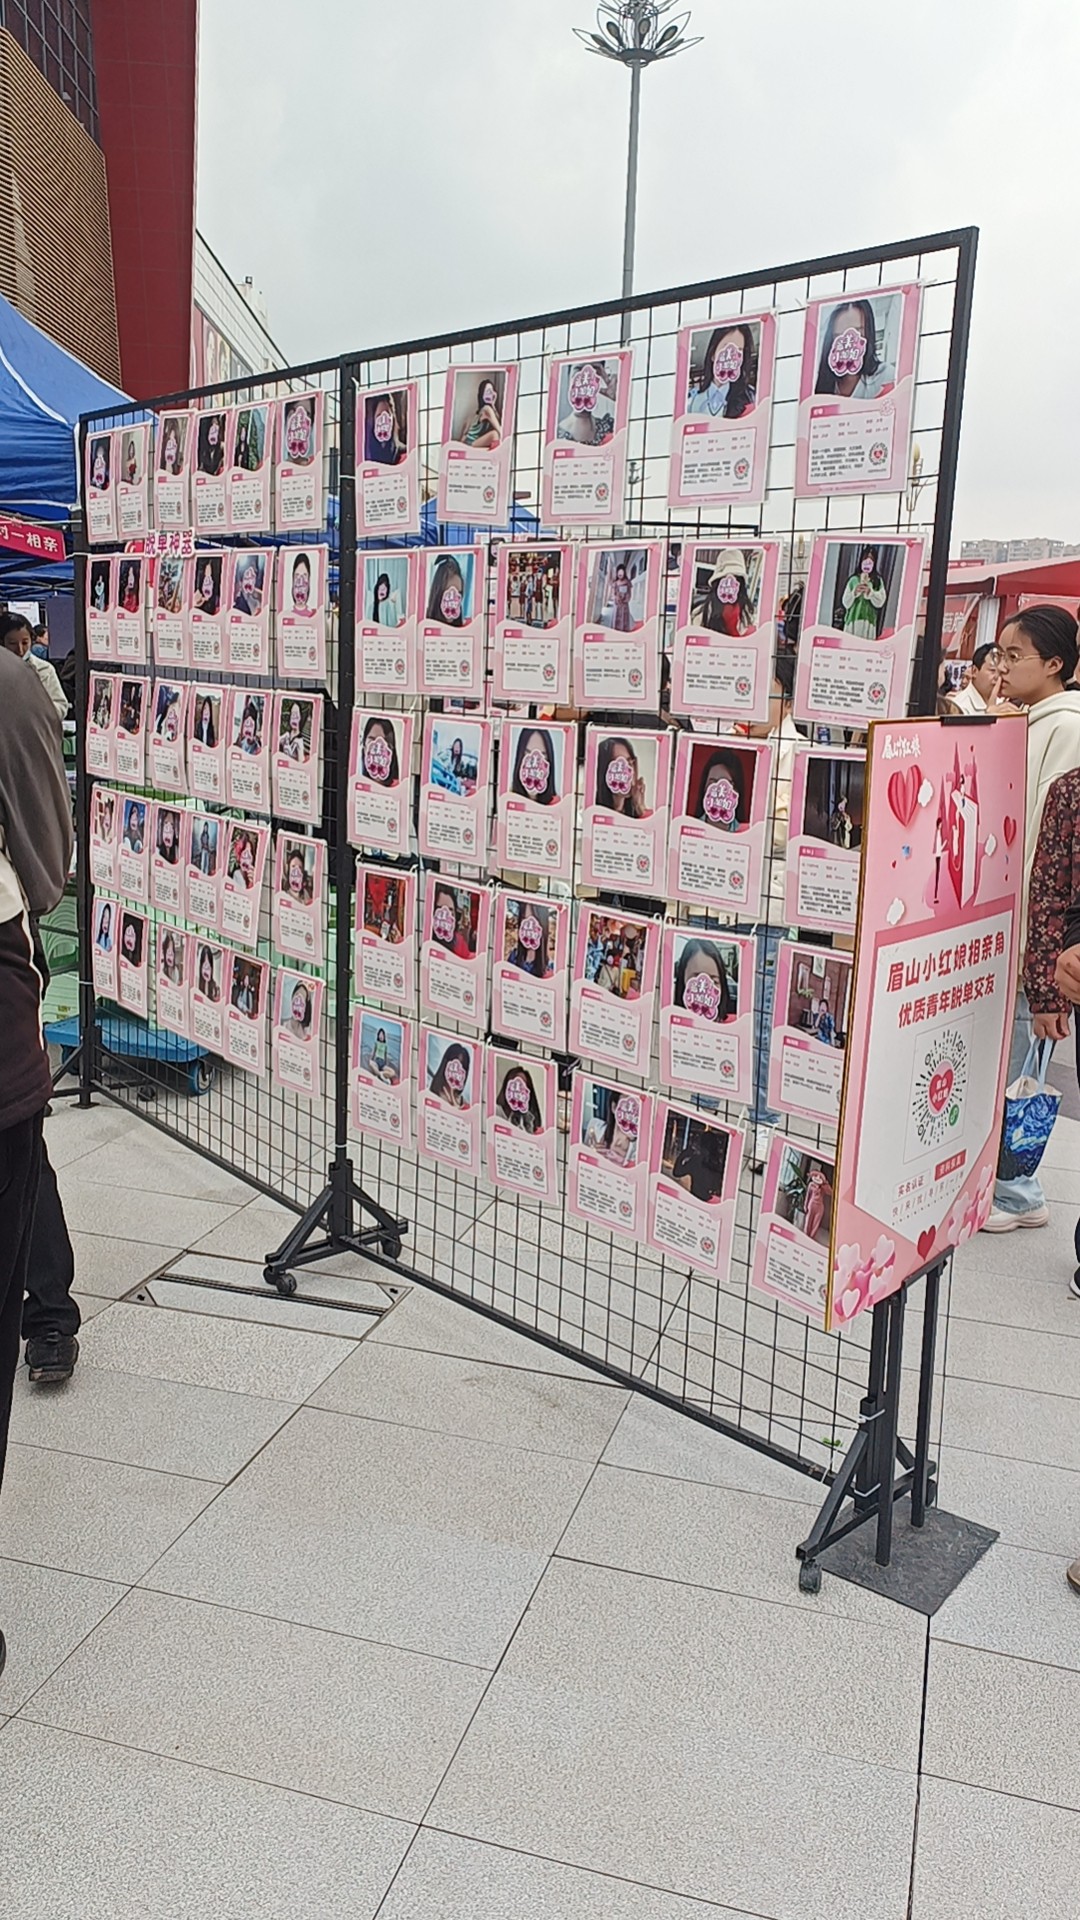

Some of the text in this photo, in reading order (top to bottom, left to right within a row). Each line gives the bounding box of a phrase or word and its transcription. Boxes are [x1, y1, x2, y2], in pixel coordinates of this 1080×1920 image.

[886, 931, 1005, 992] 眉山小红娘相亲角
[898, 972, 995, 1029] 优质青年脱单交友
[898, 1175, 924, 1198] 实名认证
